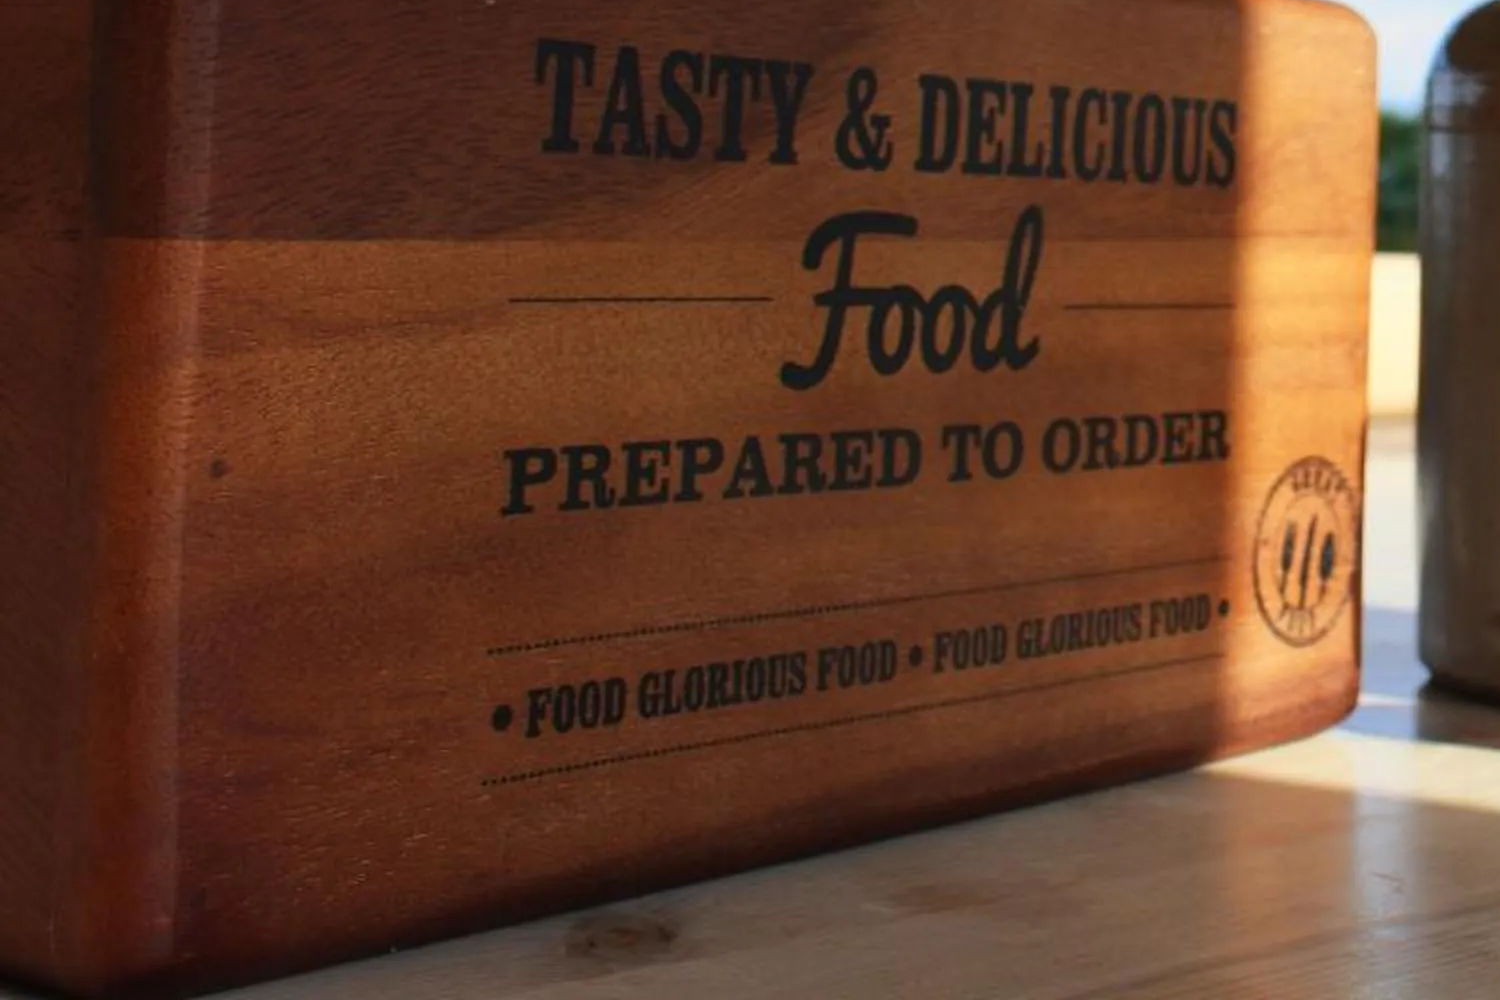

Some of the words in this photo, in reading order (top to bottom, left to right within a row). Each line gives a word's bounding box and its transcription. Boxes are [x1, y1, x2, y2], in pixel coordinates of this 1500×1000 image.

[534, 38, 814, 165] TASTY
[835, 66, 892, 172] &
[914, 74, 1239, 189] DELICIOUS
[778, 204, 1044, 391] Food
[500, 428, 921, 517] PREPARED
[942, 421, 1024, 483] TO
[1042, 408, 1230, 474] ORDER
[524, 677, 627, 738] FOOD
[637, 651, 807, 719] GLORIOUS
[817, 640, 897, 692] FOOD
[934, 624, 1007, 673] FOOD
[1017, 604, 1141, 659] GLORIOUS
[1149, 592, 1212, 637] FOOD
